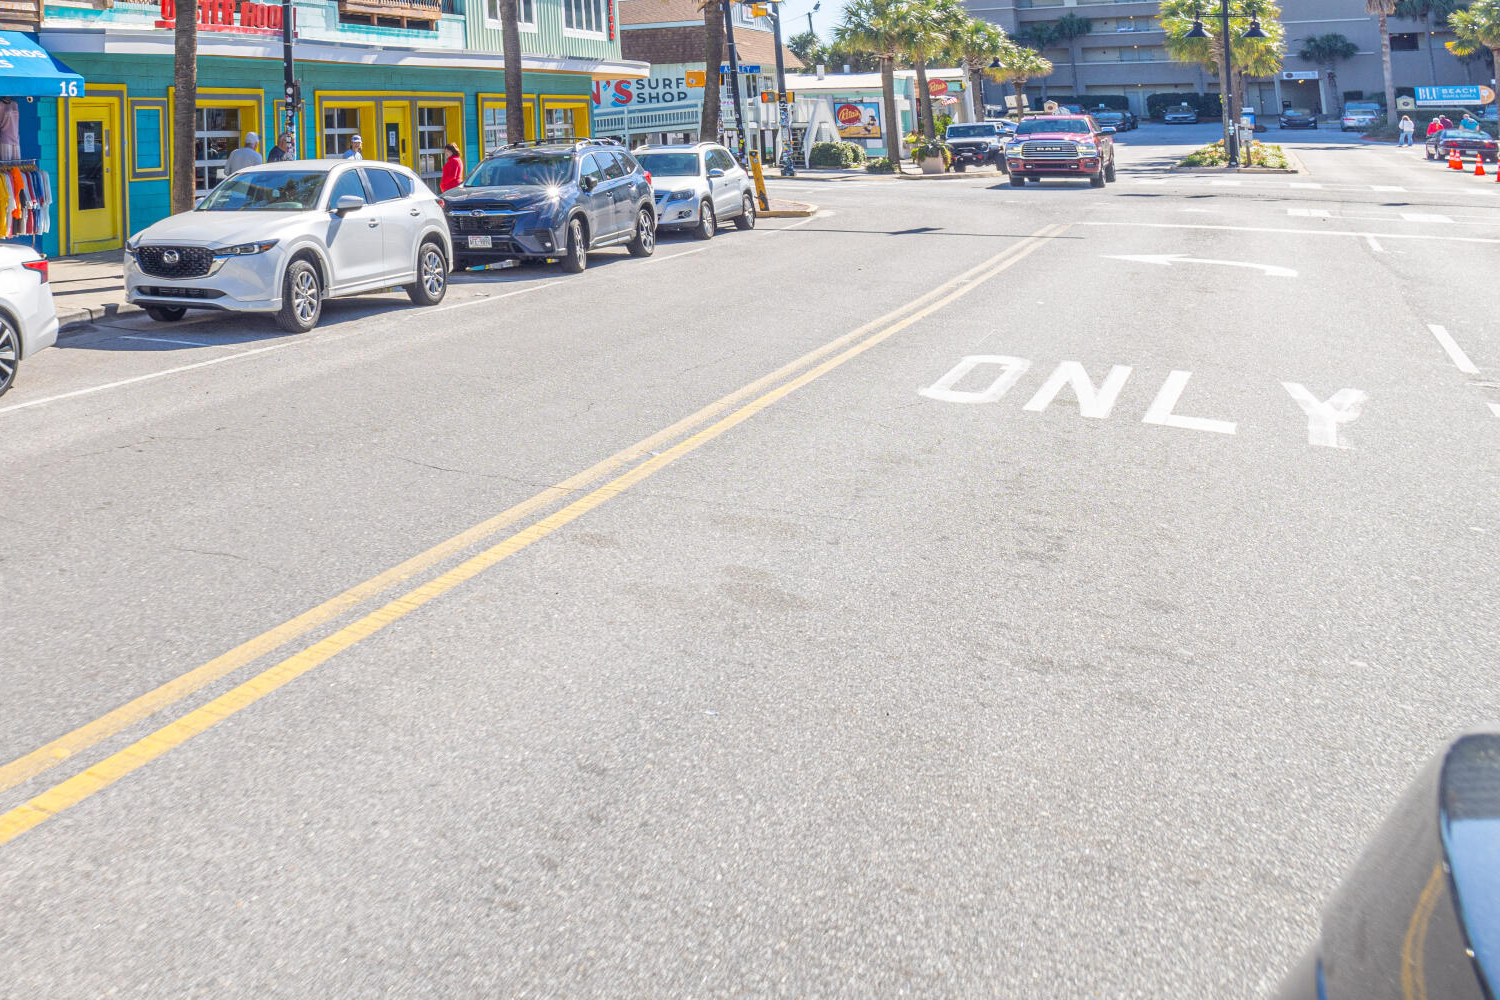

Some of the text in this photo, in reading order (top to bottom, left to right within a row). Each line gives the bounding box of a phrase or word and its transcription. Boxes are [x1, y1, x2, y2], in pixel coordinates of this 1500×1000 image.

[59, 81, 78, 97] 16
[636, 77, 685, 90] SURF
[636, 91, 688, 104] SHOP
[918, 354, 1370, 450] ONLY
